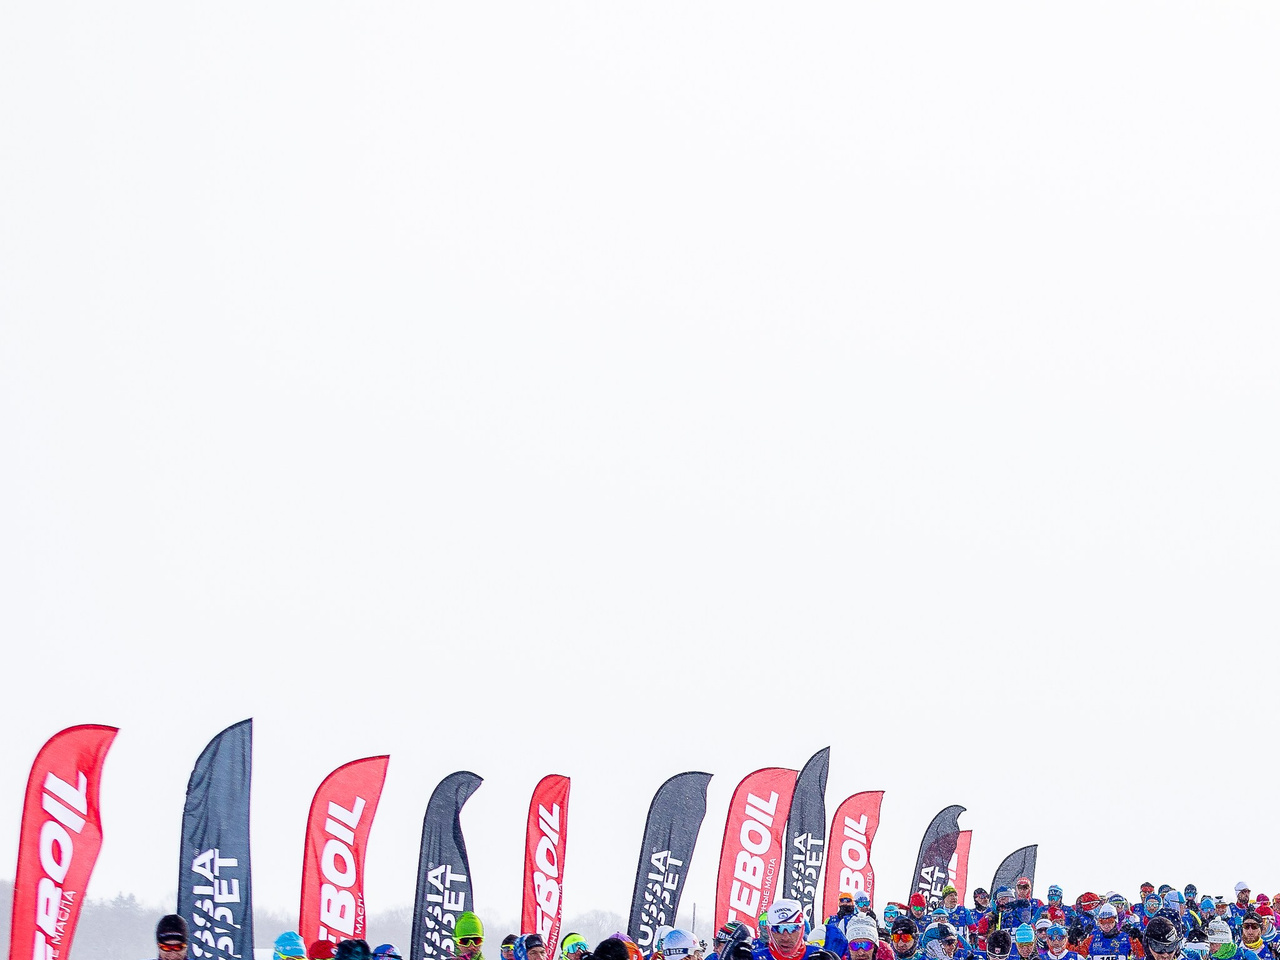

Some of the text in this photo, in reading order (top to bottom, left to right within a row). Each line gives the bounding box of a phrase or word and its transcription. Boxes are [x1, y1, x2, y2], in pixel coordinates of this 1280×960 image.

[318, 796, 366, 943] BOIL
[764, 858, 777, 890] МАСЛА
[790, 833, 808, 898] SSIA
[803, 833, 824, 922] OPPET
[839, 814, 868, 896] BOIL
[440, 864, 467, 960] PPET
